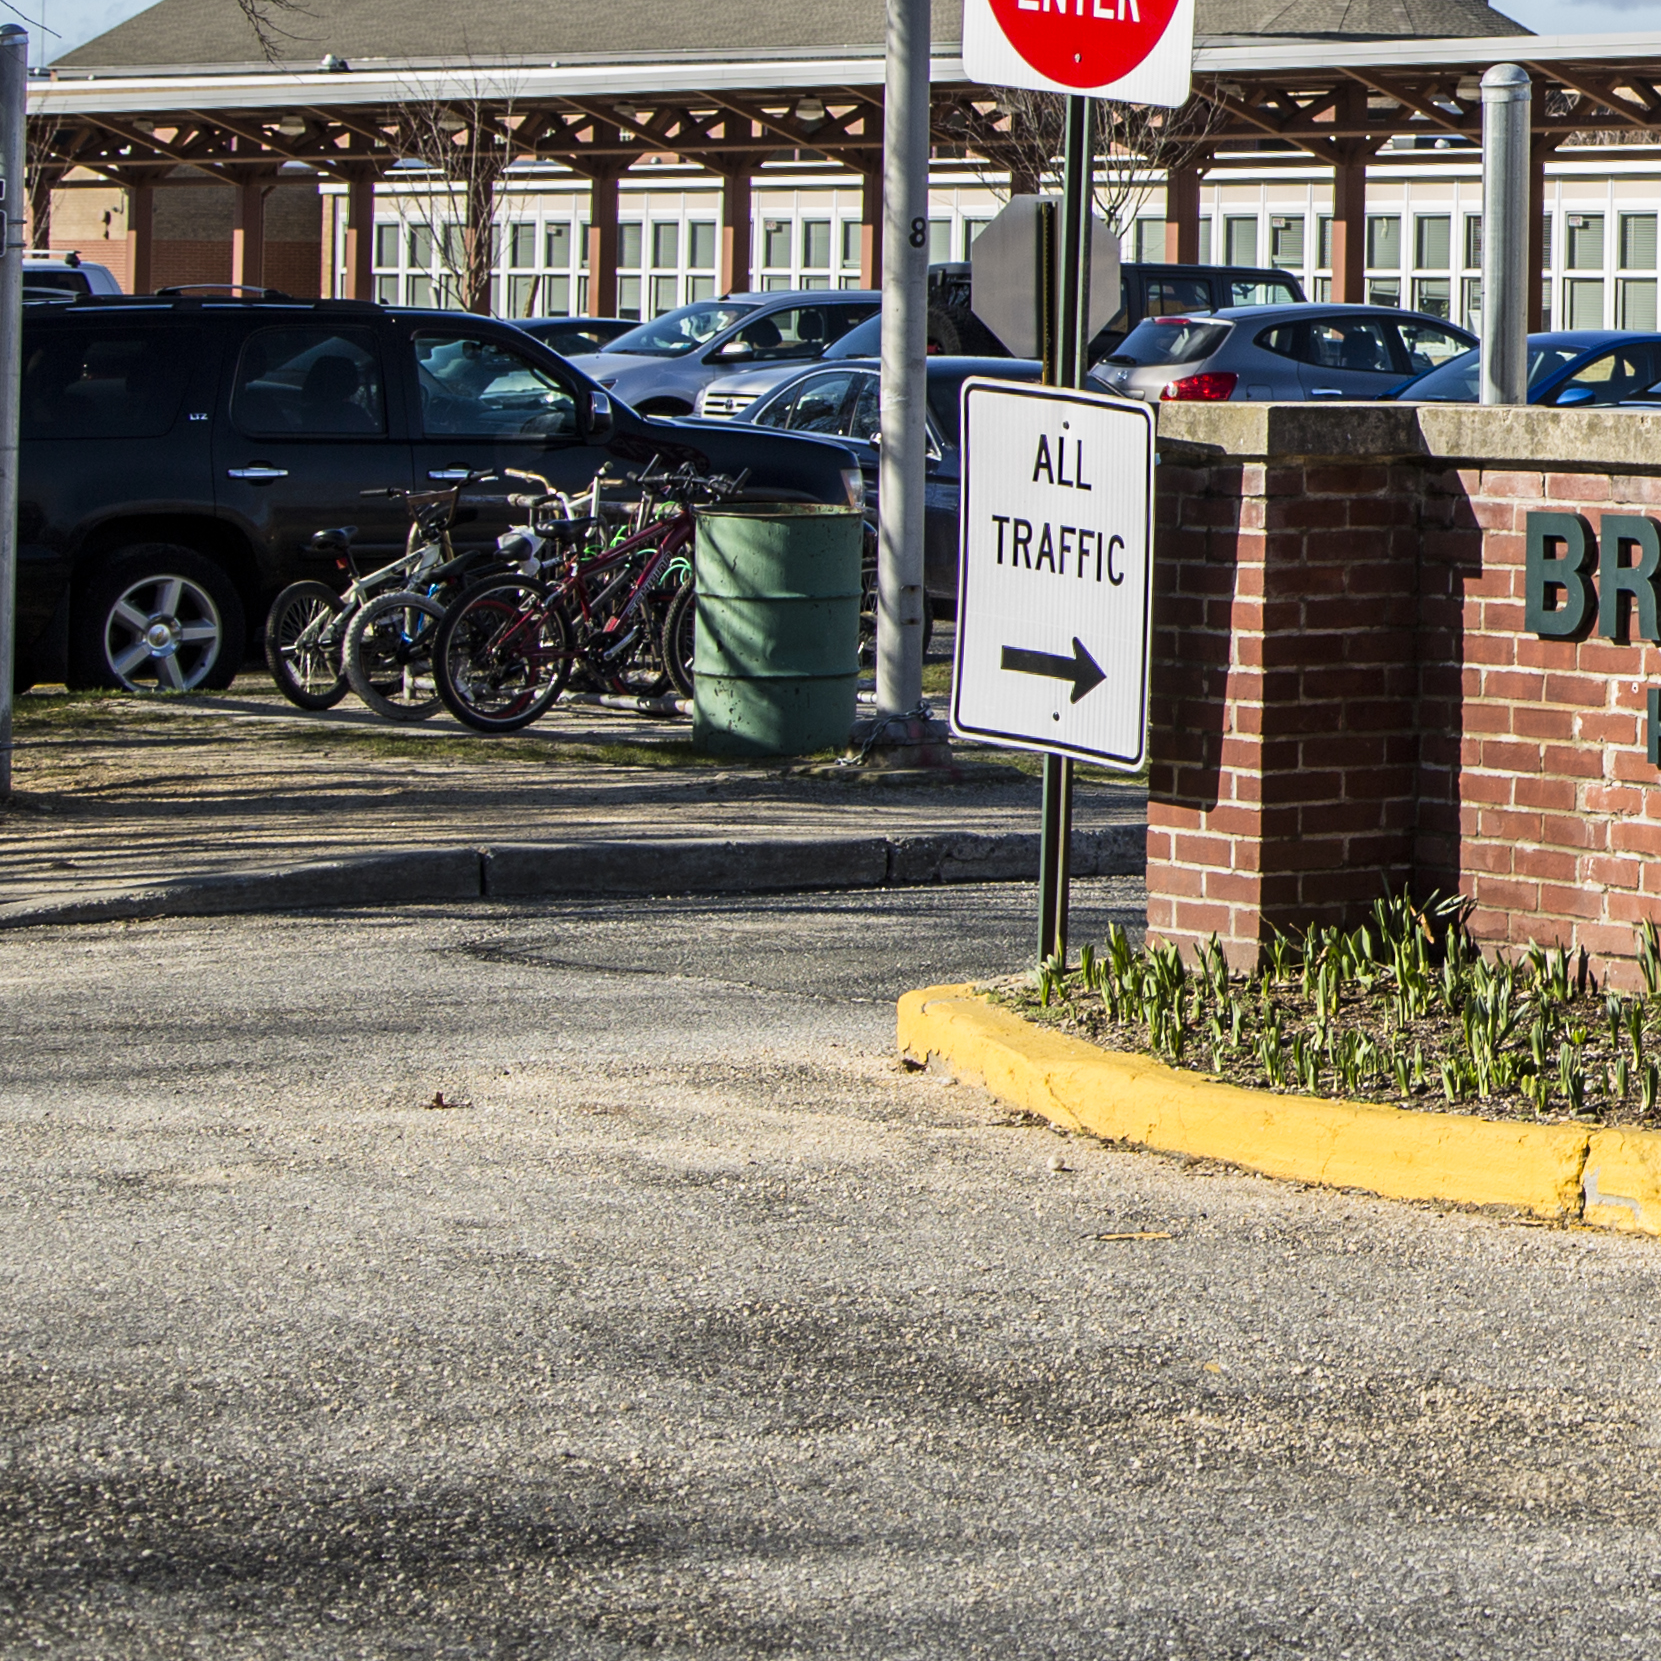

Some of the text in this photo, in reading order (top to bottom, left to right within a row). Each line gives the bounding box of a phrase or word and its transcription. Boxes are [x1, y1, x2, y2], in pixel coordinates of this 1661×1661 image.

[909, 216, 926, 248] 8
[189, 413, 208, 421] LTZ
[1032, 433, 1092, 491] ALL
[992, 514, 1125, 587] TRAFFIC
